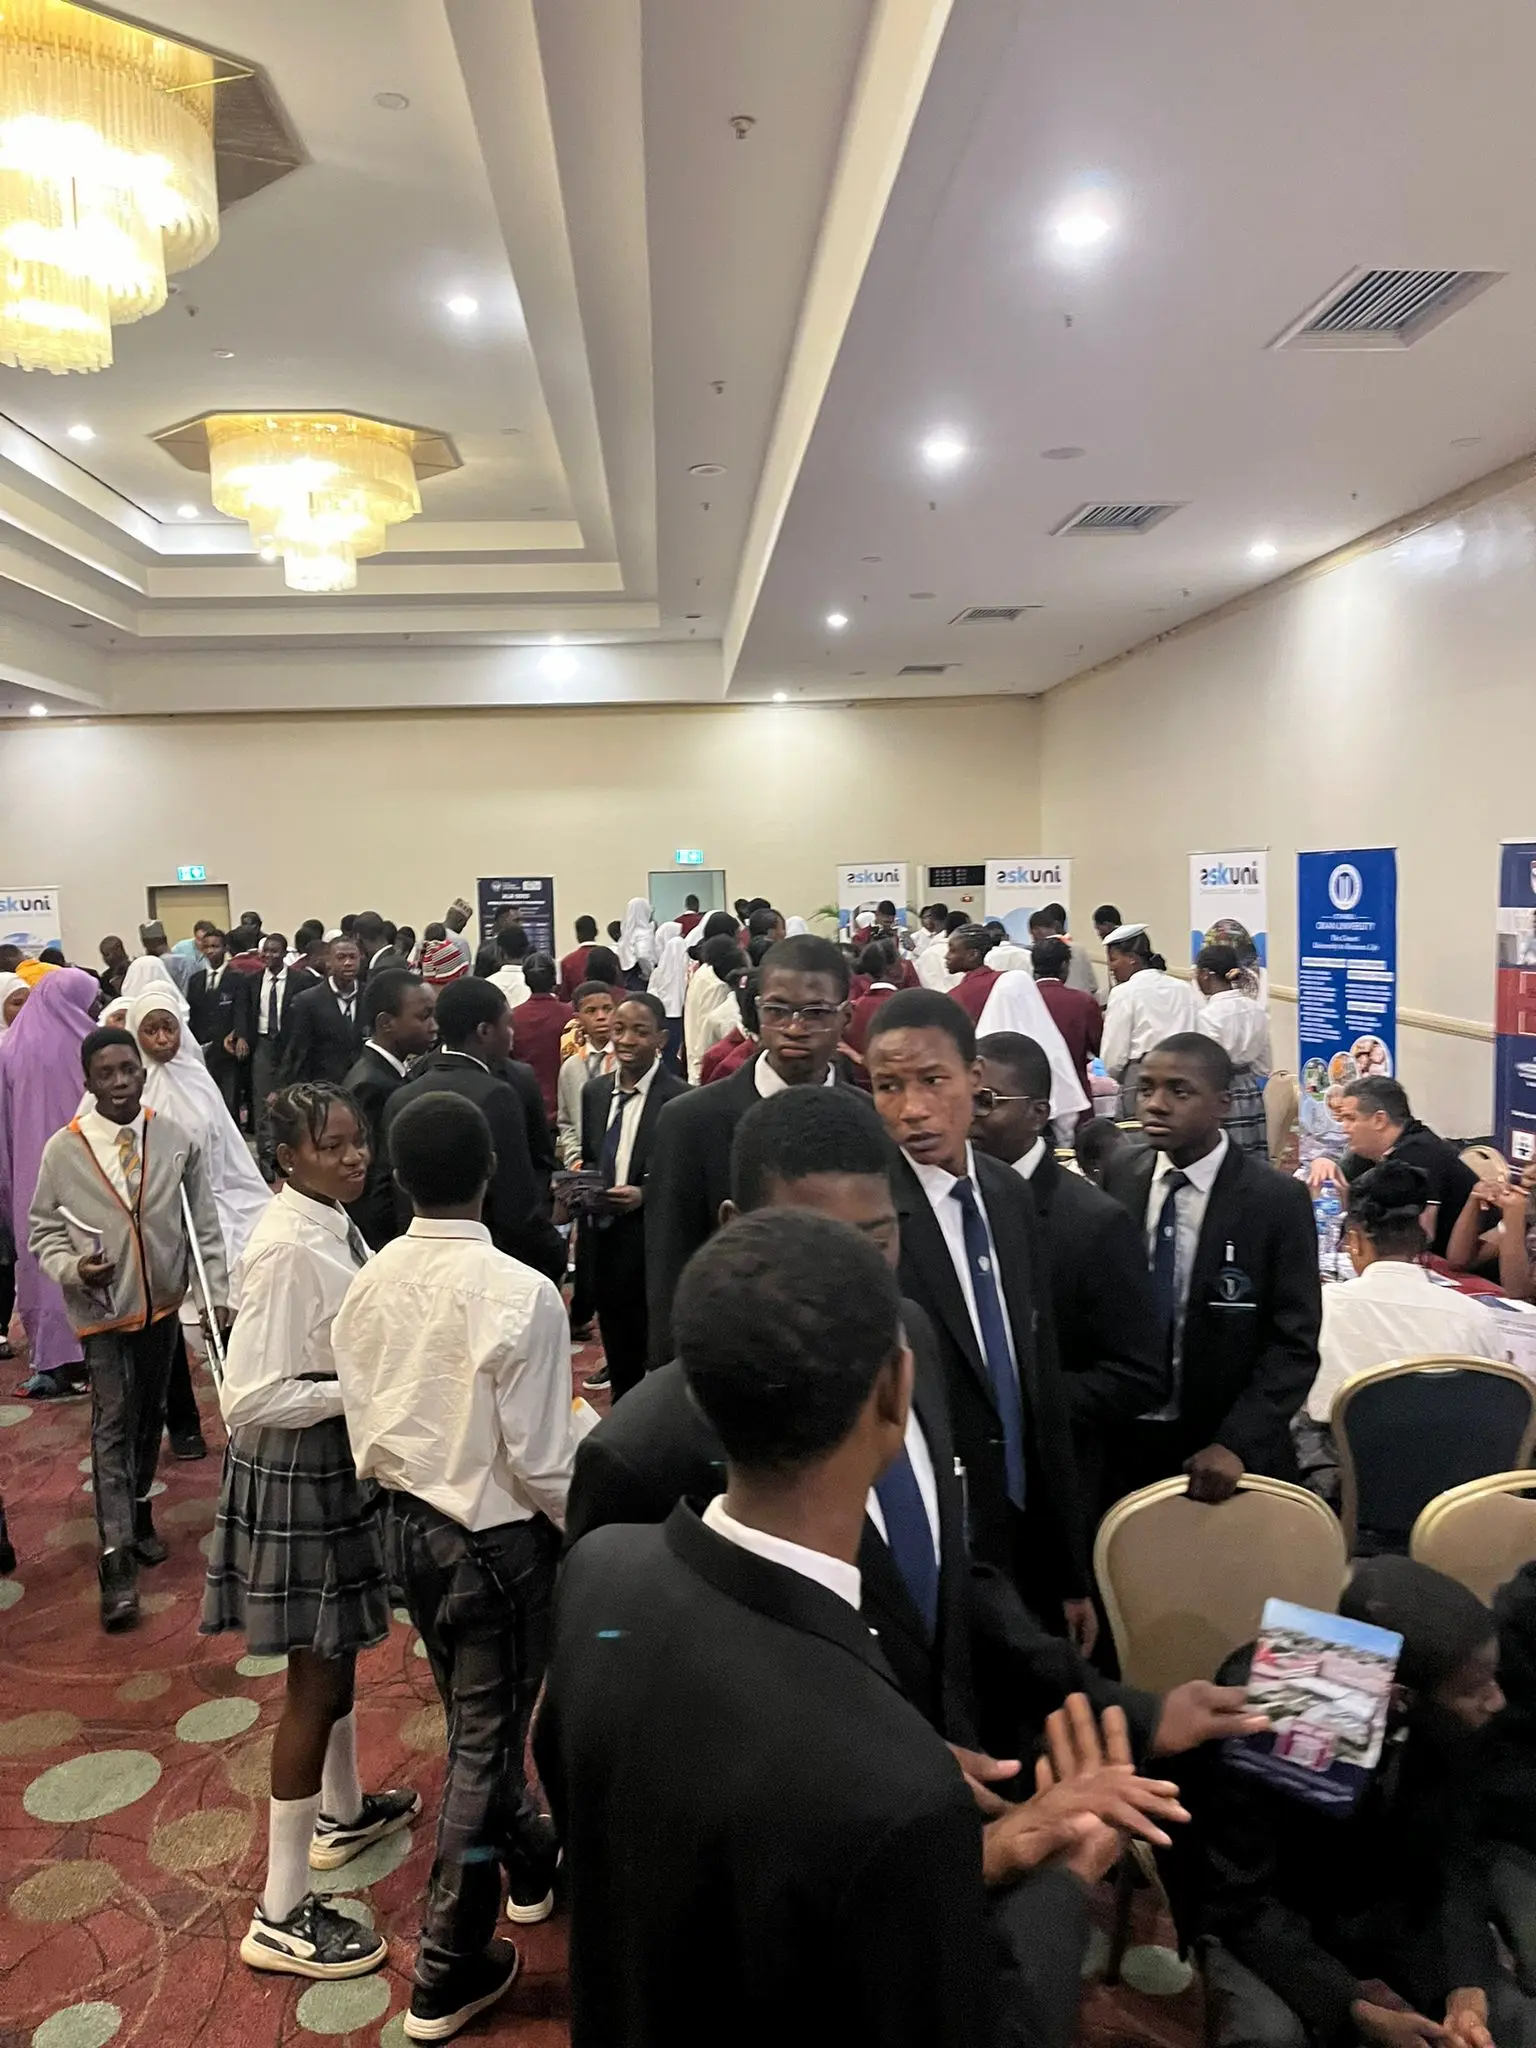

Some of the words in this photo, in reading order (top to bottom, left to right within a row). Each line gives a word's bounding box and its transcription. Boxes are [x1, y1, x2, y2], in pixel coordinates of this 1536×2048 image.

[847, 868, 900, 883] askuni
[997, 865, 1062, 884] askuni
[1200, 861, 1258, 885] askuni
